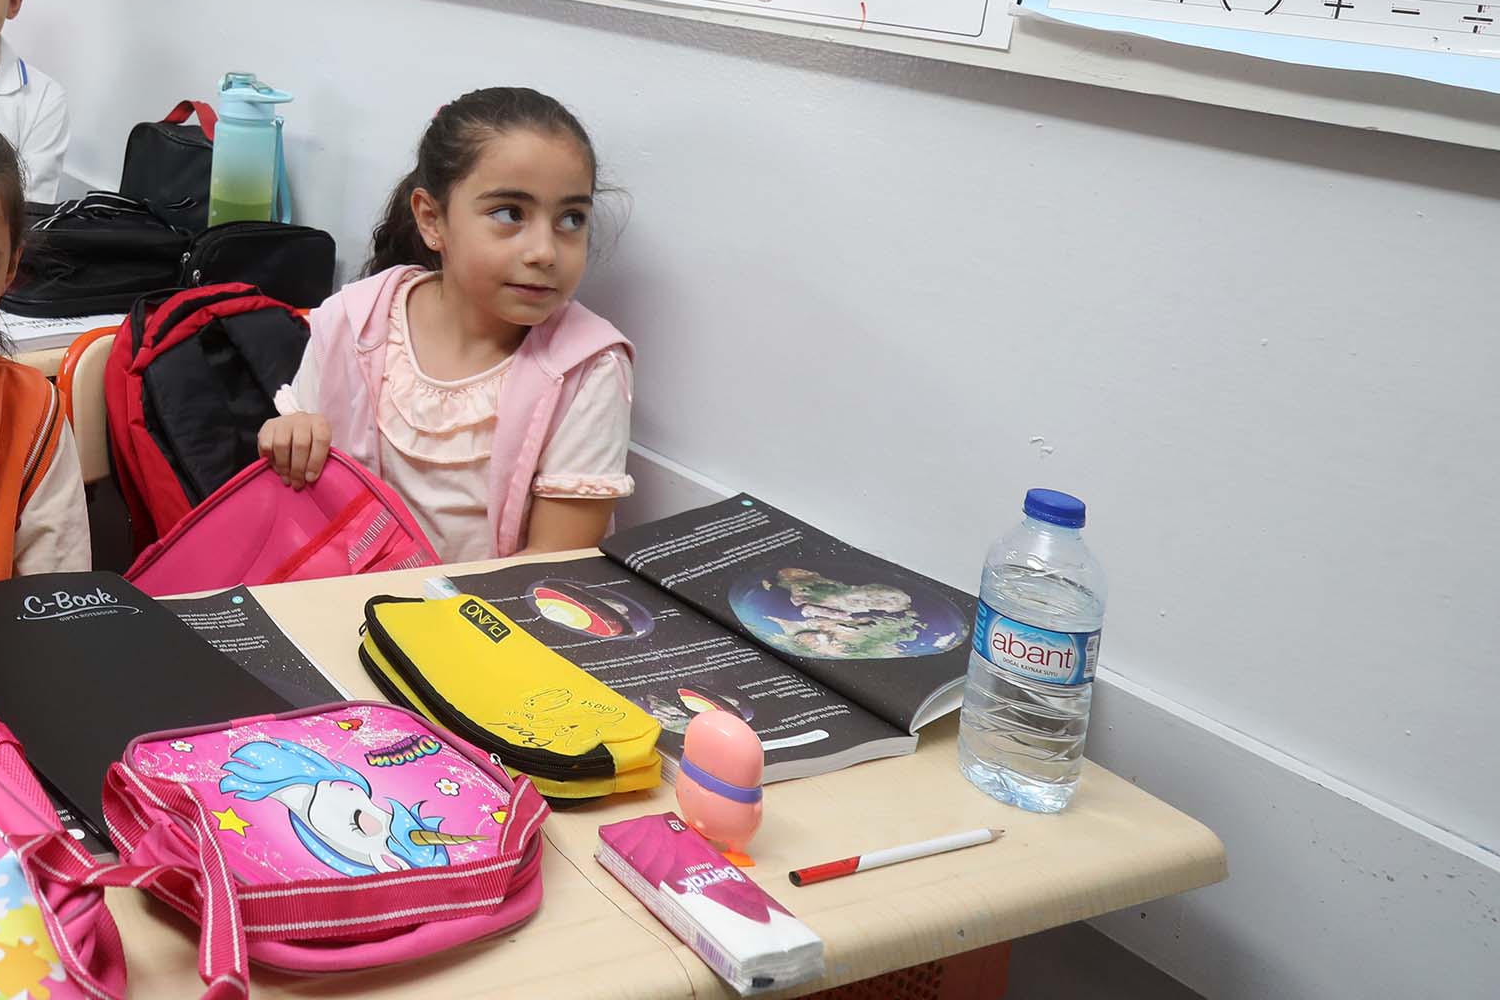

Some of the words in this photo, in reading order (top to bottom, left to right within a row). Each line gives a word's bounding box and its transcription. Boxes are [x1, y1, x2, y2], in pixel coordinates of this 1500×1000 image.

[24, 587, 118, 614] C-Book
[462, 603, 508, 639] PIANO
[992, 632, 1073, 669] abant
[1002, 656, 1020, 668] DOĞAL
[676, 865, 746, 895] Berrak
[684, 862, 713, 876] Mendil
